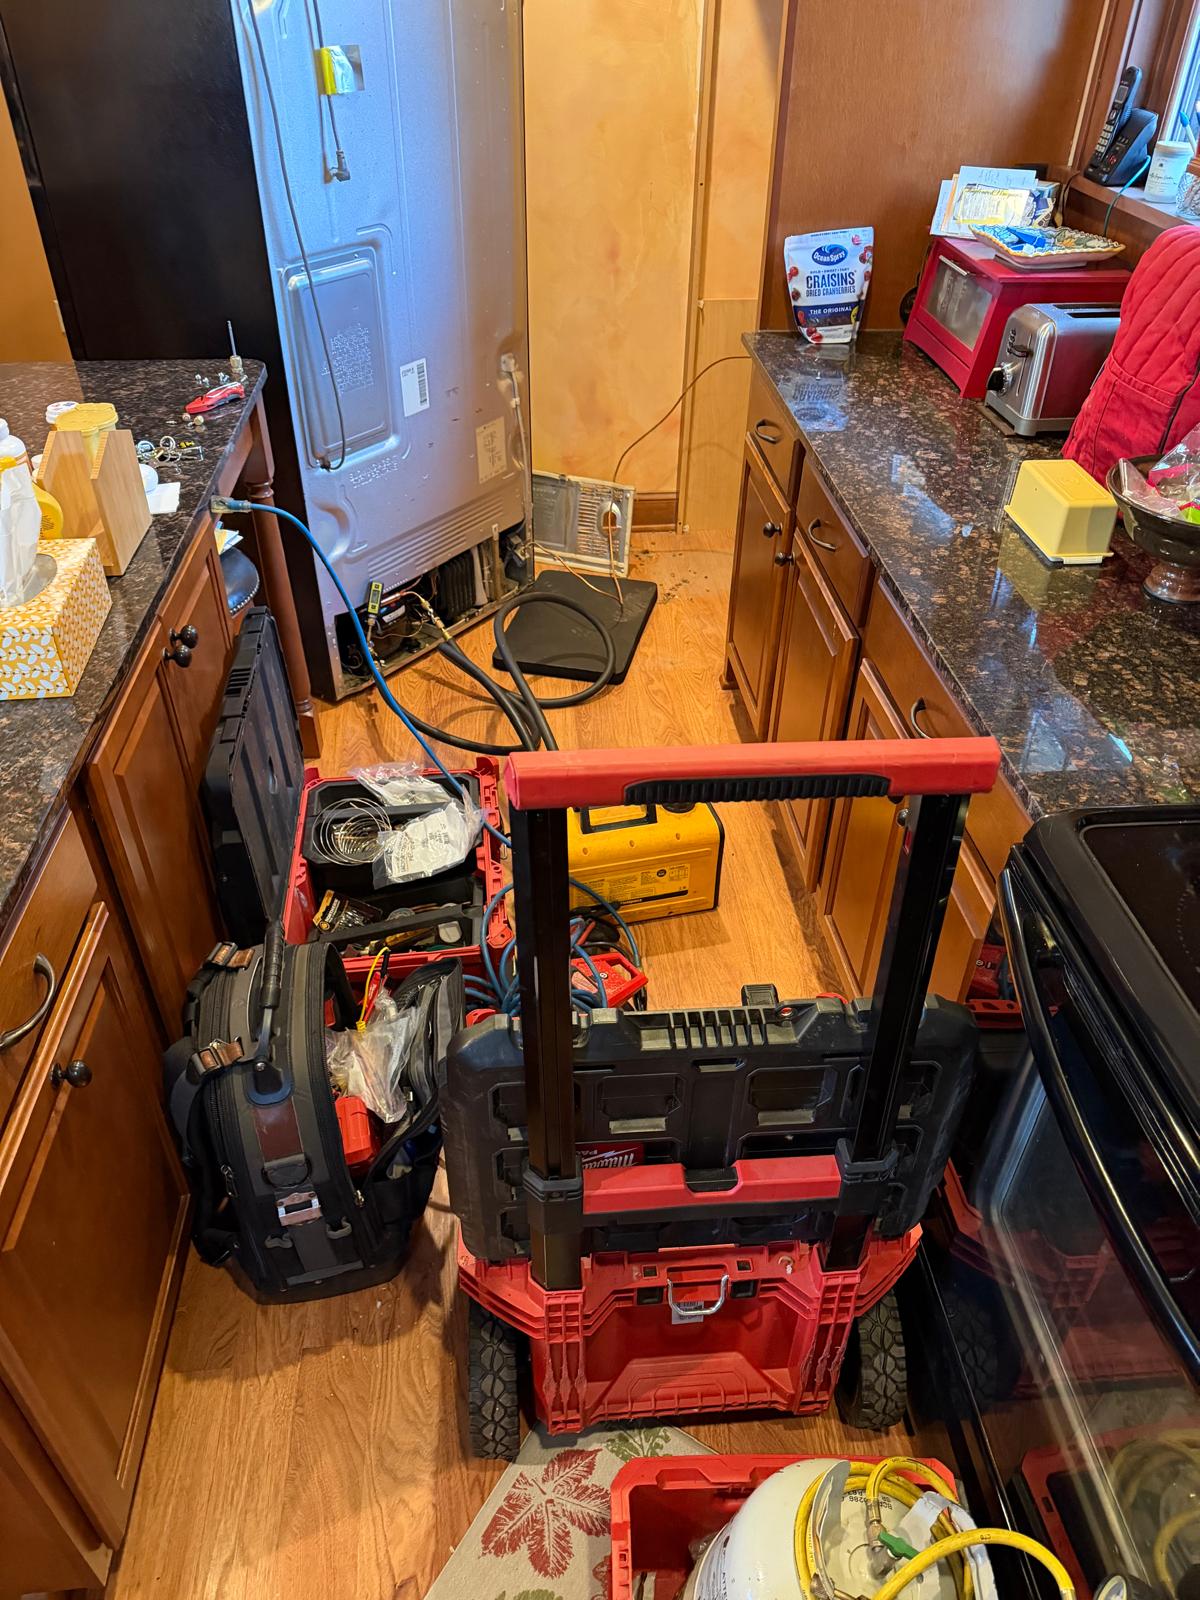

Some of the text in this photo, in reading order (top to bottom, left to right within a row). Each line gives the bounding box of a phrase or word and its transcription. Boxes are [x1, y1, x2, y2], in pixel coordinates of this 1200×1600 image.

[806, 272, 856, 289] CRAISINS
[805, 285, 856, 297] DRIED CRANBERRIES
[823, 306, 852, 314] ORIGINAL
